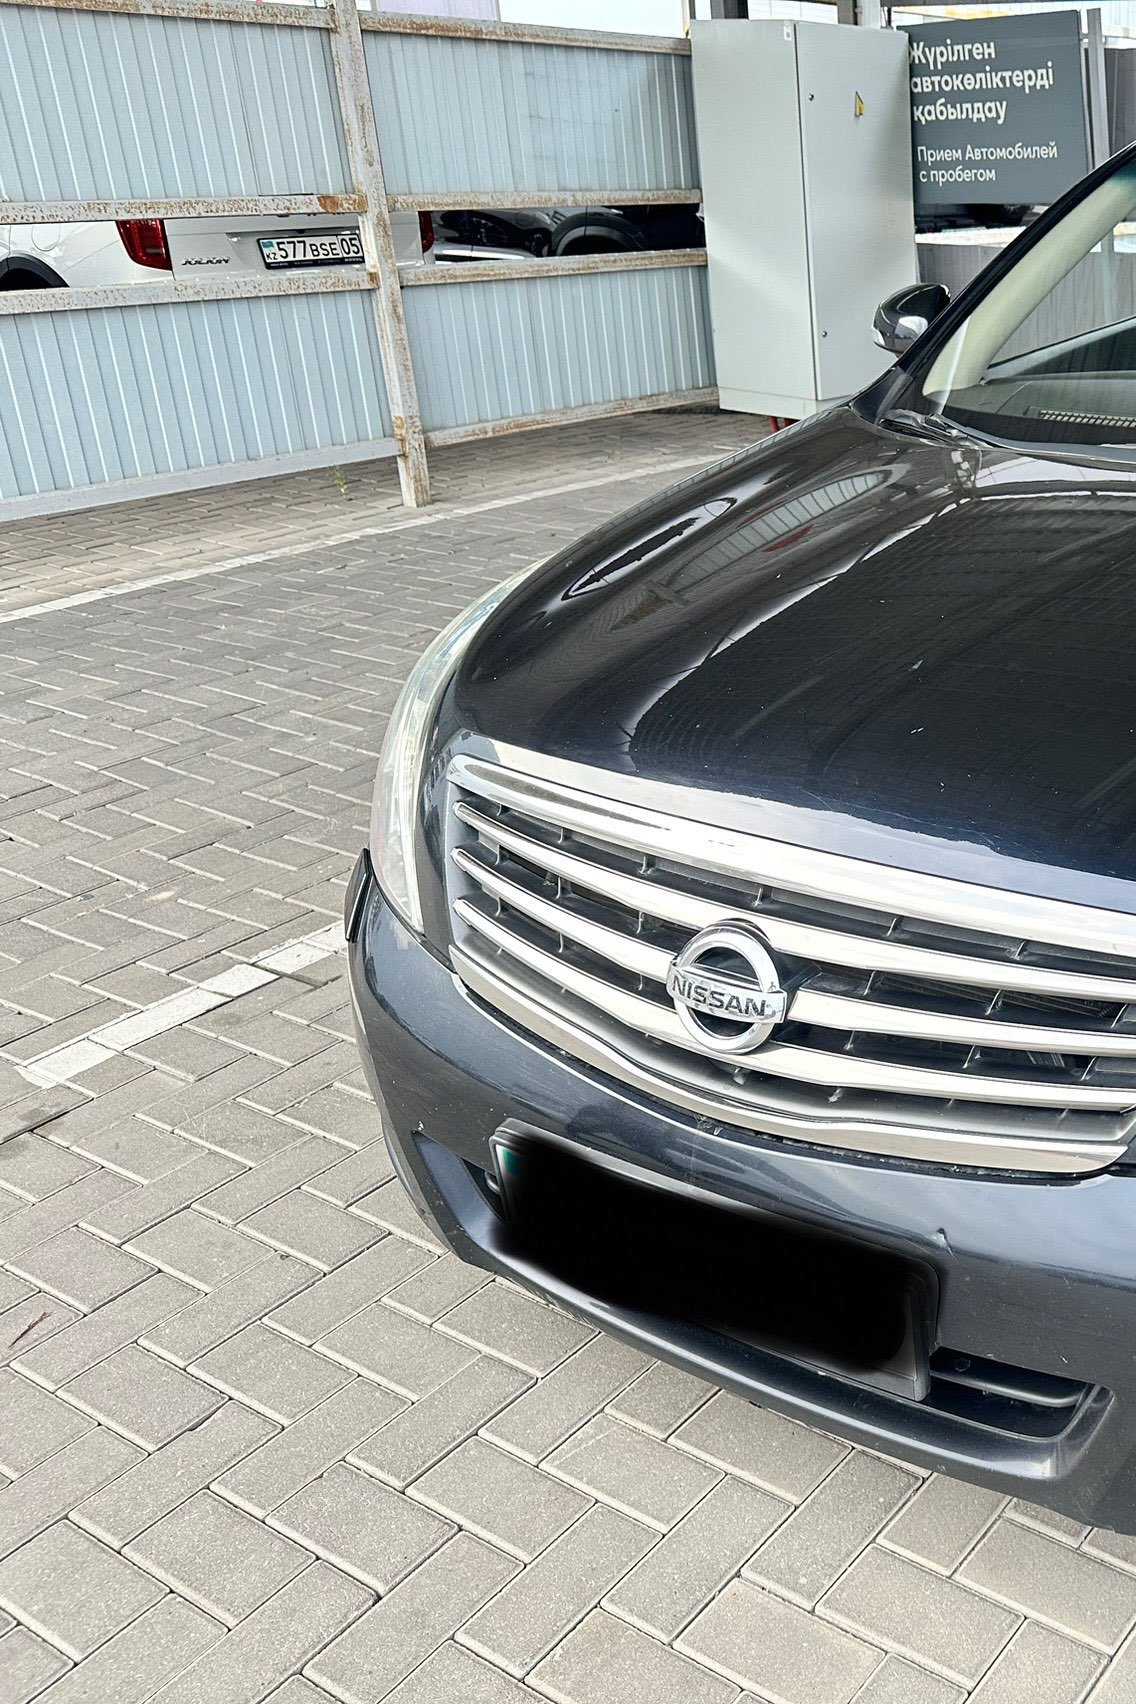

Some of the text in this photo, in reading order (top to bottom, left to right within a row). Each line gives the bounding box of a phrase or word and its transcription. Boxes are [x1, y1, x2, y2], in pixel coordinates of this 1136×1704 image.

[909, 39, 996, 70] Жүрілген
[911, 61, 1054, 93] автокөліктерді
[913, 98, 1007, 125] қабылдау
[918, 141, 1058, 166] Прием Автомобилей
[919, 165, 996, 187] с пробегом
[672, 975, 767, 1017] NISSAN
